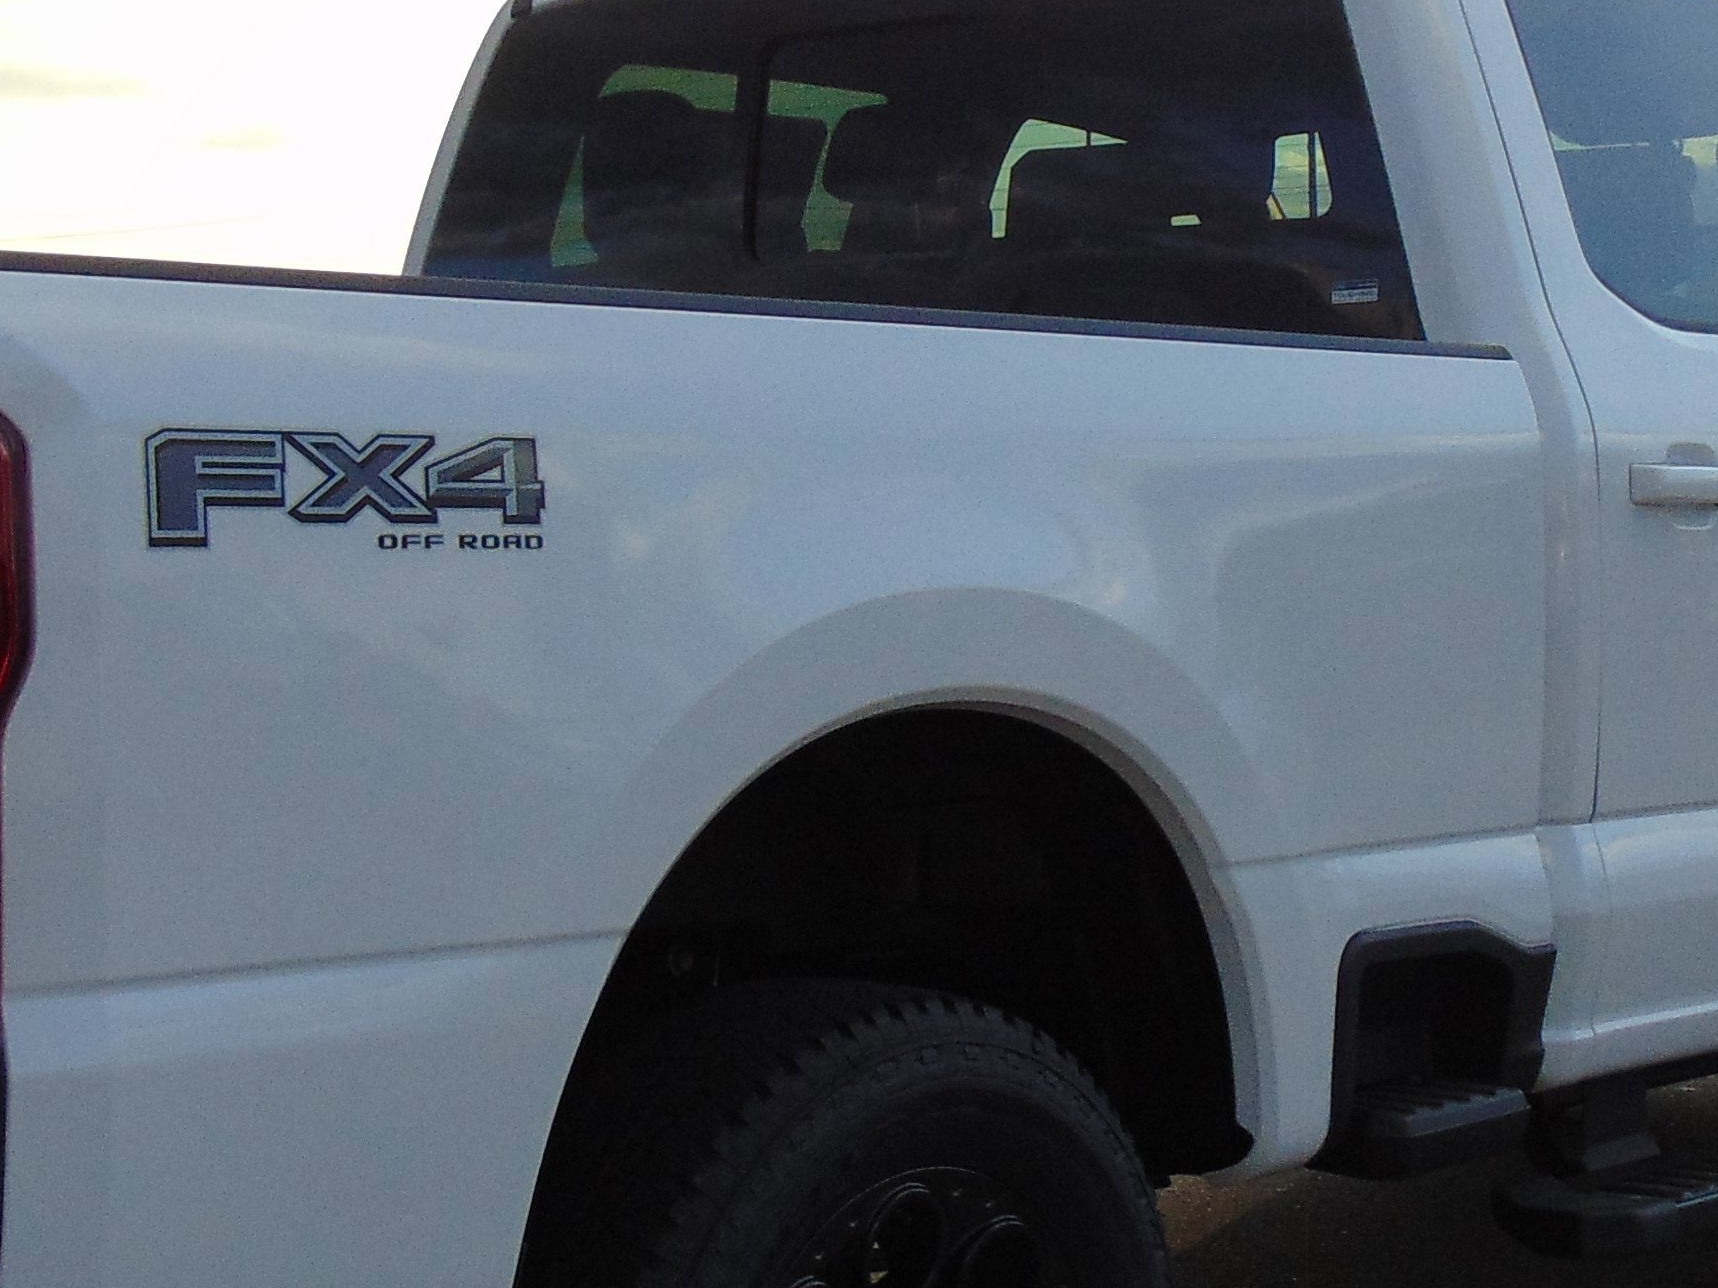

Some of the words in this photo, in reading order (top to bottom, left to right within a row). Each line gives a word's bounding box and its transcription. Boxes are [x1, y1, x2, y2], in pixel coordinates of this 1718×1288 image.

[144, 427, 547, 548] FX4
[377, 533, 444, 550] OFF
[458, 533, 545, 550] ROAD
